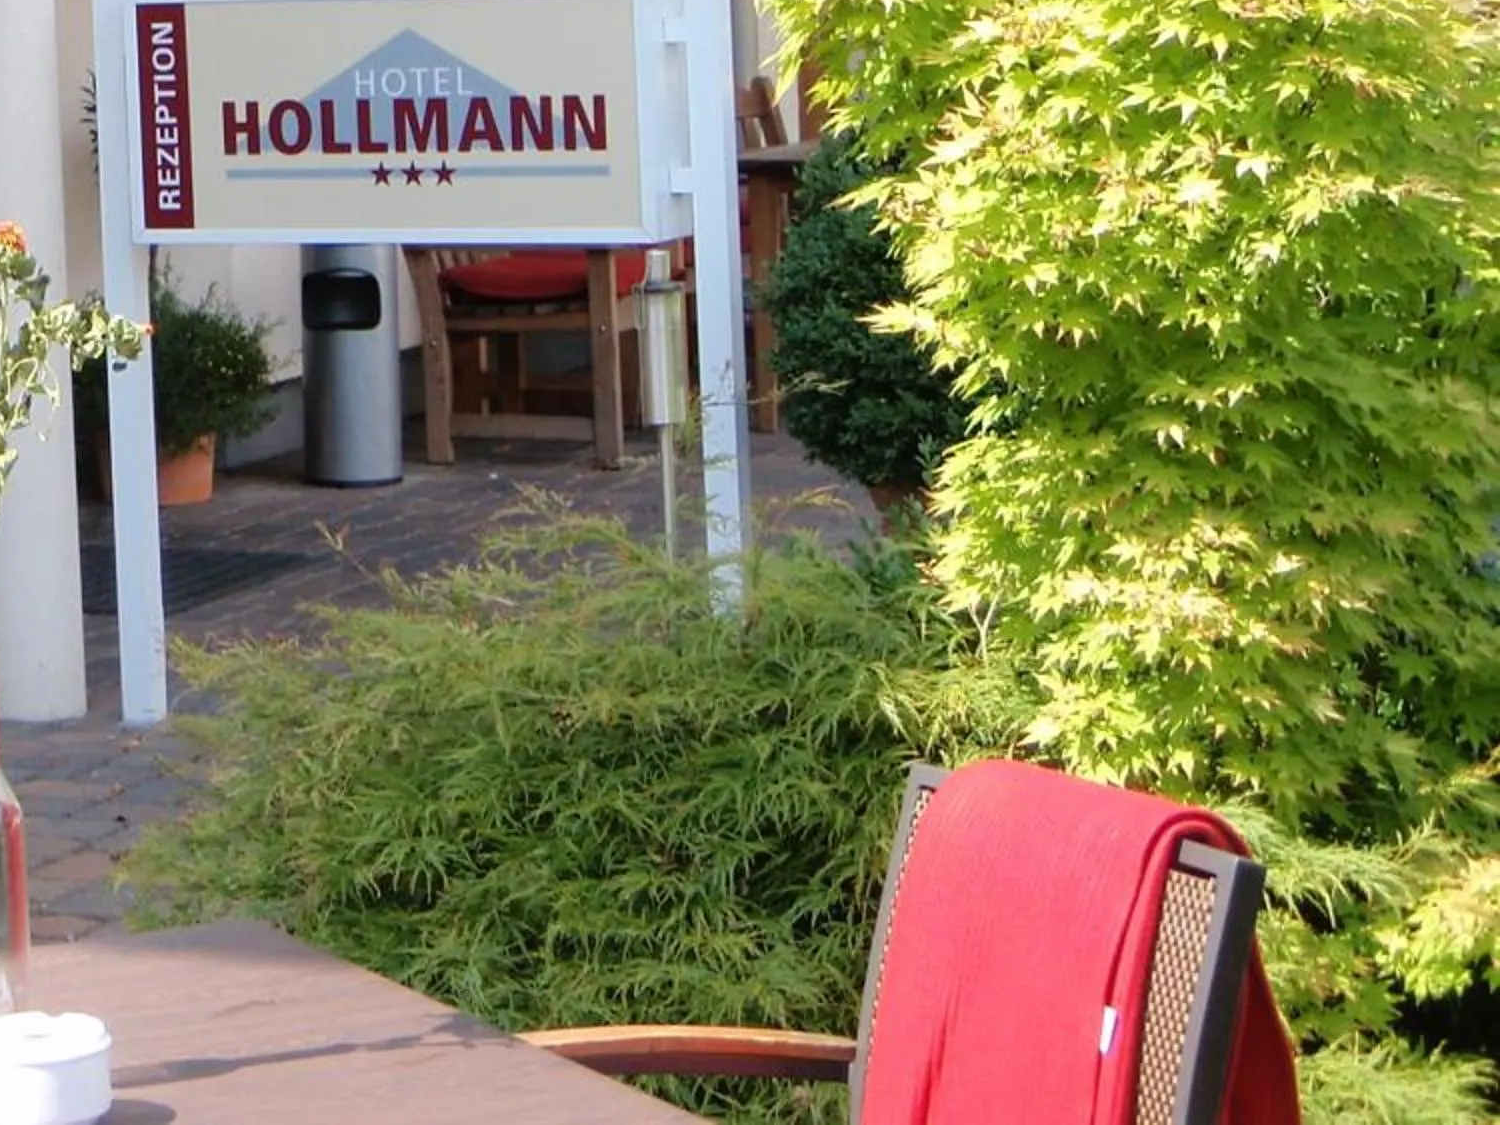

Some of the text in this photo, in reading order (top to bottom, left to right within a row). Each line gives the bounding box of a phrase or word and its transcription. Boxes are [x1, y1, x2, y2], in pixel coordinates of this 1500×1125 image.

[355, 67, 473, 98] HOTEL
[151, 21, 181, 211] REZEPTION
[222, 94, 607, 155] HOLLMANN
